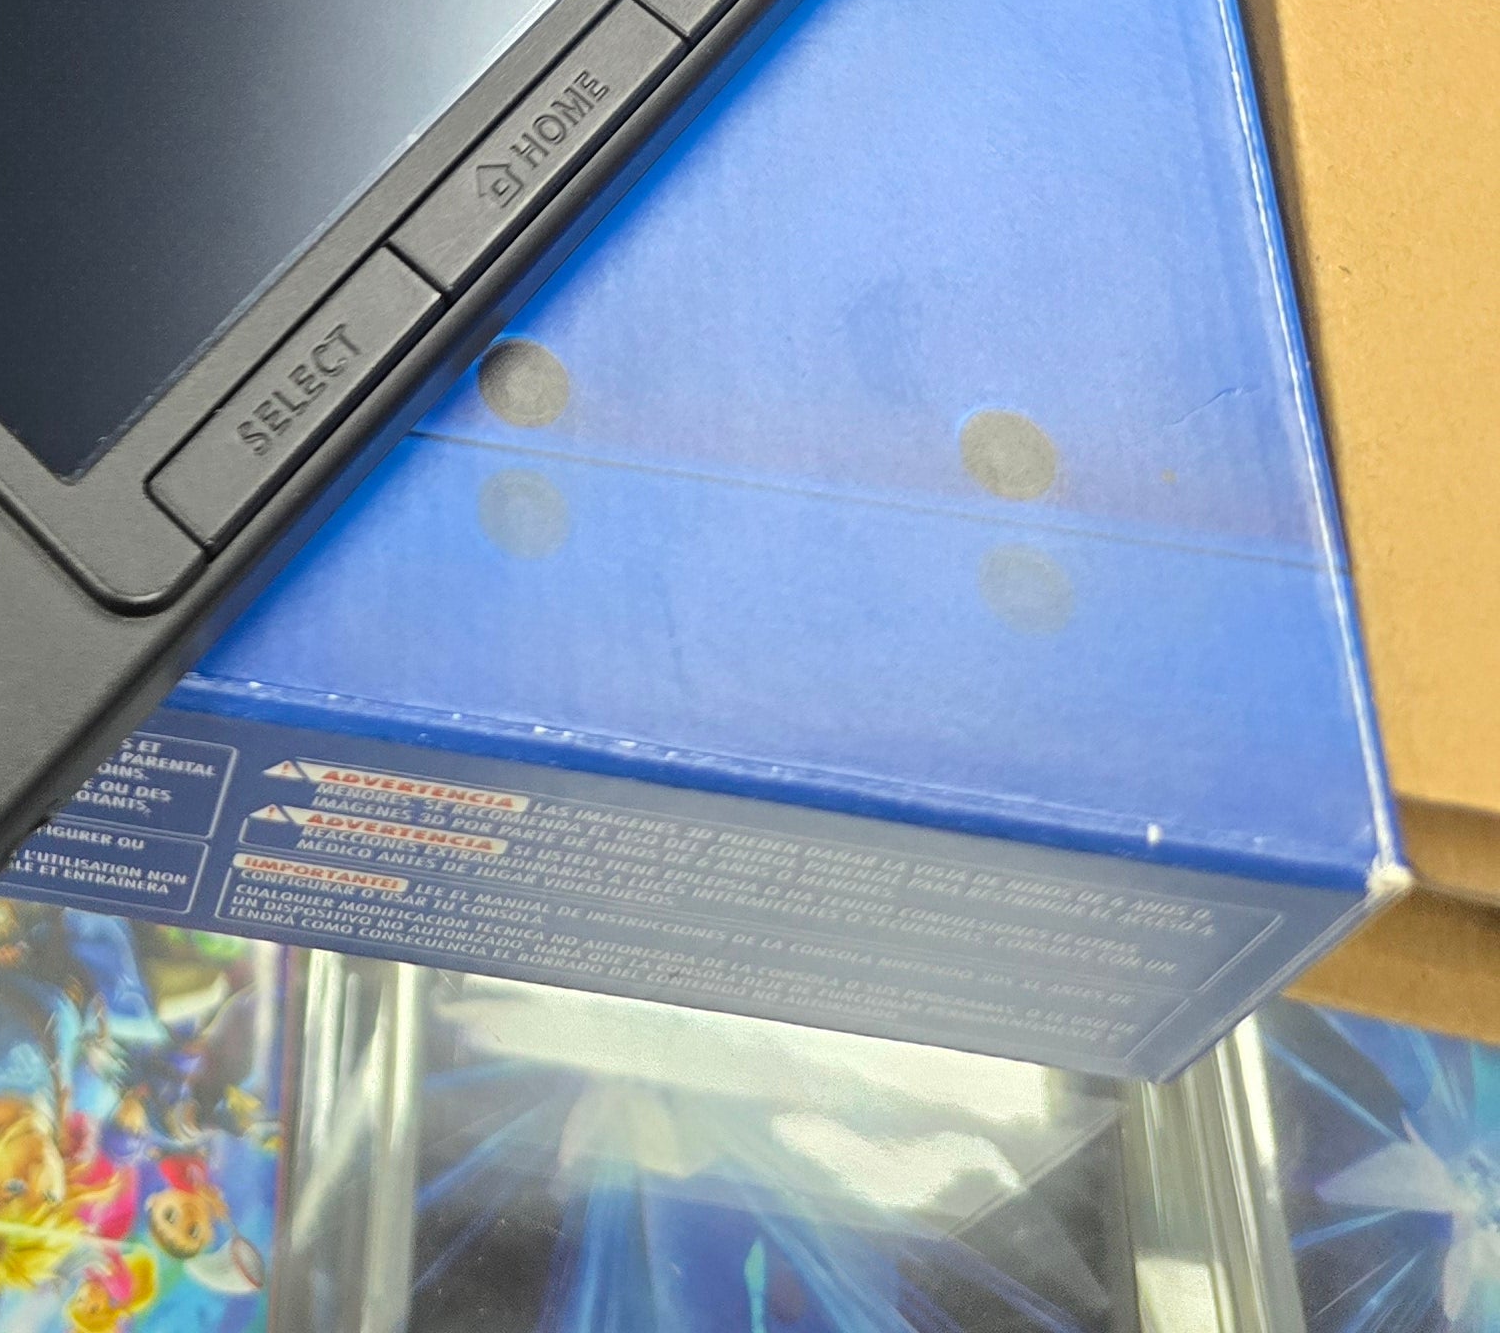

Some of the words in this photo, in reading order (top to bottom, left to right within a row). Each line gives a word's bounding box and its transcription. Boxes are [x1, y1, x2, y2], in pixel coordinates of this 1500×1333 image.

[509, 70, 610, 170] HOME
[237, 323, 362, 456] SELECT
[118, 752, 218, 777] PARENTAL
[136, 740, 160, 753] ET
[70, 790, 154, 814] OTANTS,
[98, 781, 130, 794] OU
[134, 786, 174, 801] DES
[322, 769, 516, 808] ADVERTENCIA
[532, 803, 570, 816] LAS
[718, 833, 800, 853] PUEDEN
[116, 836, 144, 850] OU
[308, 813, 494, 849] ADVERTENCIA
[512, 846, 530, 855] SI
[536, 850, 598, 866] USTED
[604, 861, 658, 875] TIENE
[662, 870, 758, 891] EPILEPSIA
[418, 813, 446, 825] 3D
[452, 819, 492, 832] POR
[496, 826, 556, 842] PARTE
[562, 836, 588, 848] DE
[662, 853, 690, 864] DE
[422, 799, 446, 811] SE
[452, 804, 582, 833] RECOMIENDA
[586, 826, 608, 837] EL
[616, 830, 660, 845] USO
[662, 838, 700, 851] DEL
[706, 845, 796, 866] CONTROL
[22, 850, 142, 878] L'UTILISATION
[146, 870, 186, 885] NON
[38, 865, 58, 876] ET
[302, 826, 418, 851] REACCIONES
[424, 845, 604, 881] EXTRAORDINARIAS
[608, 875, 624, 884] A
[628, 878, 688, 894] LUCES
[378, 852, 436, 868] ANTES
[442, 862, 468, 873] DE
[474, 867, 536, 884] JUGAR
[240, 869, 356, 894] CONFIGURAR
[360, 888, 374, 897] O
[380, 891, 428, 905] USAR
[432, 900, 456, 910] TU
[414, 884, 446, 895] LEE
[450, 890, 472, 900] EL
[474, 894, 552, 912] MANUAL
[556, 907, 582, 917] DE
[586, 911, 728, 941] INSTRUCCIONES
[232, 895, 258, 906] UN
[264, 901, 372, 924] DISPOSITIVO
[376, 919, 404, 929] NO
[586, 953, 624, 965] QUE
[628, 960, 650, 969] LA
[236, 884, 336, 906] CUALQUIER
[550, 935, 578, 945] NO
[582, 940, 698, 964] AUTORIZADA
[300, 919, 354, 933] COMO
[358, 928, 490, 955] CONSECUENCIA
[492, 950, 512, 959] EL
[516, 954, 602, 973] BORRADO
[608, 968, 638, 979] DEL
